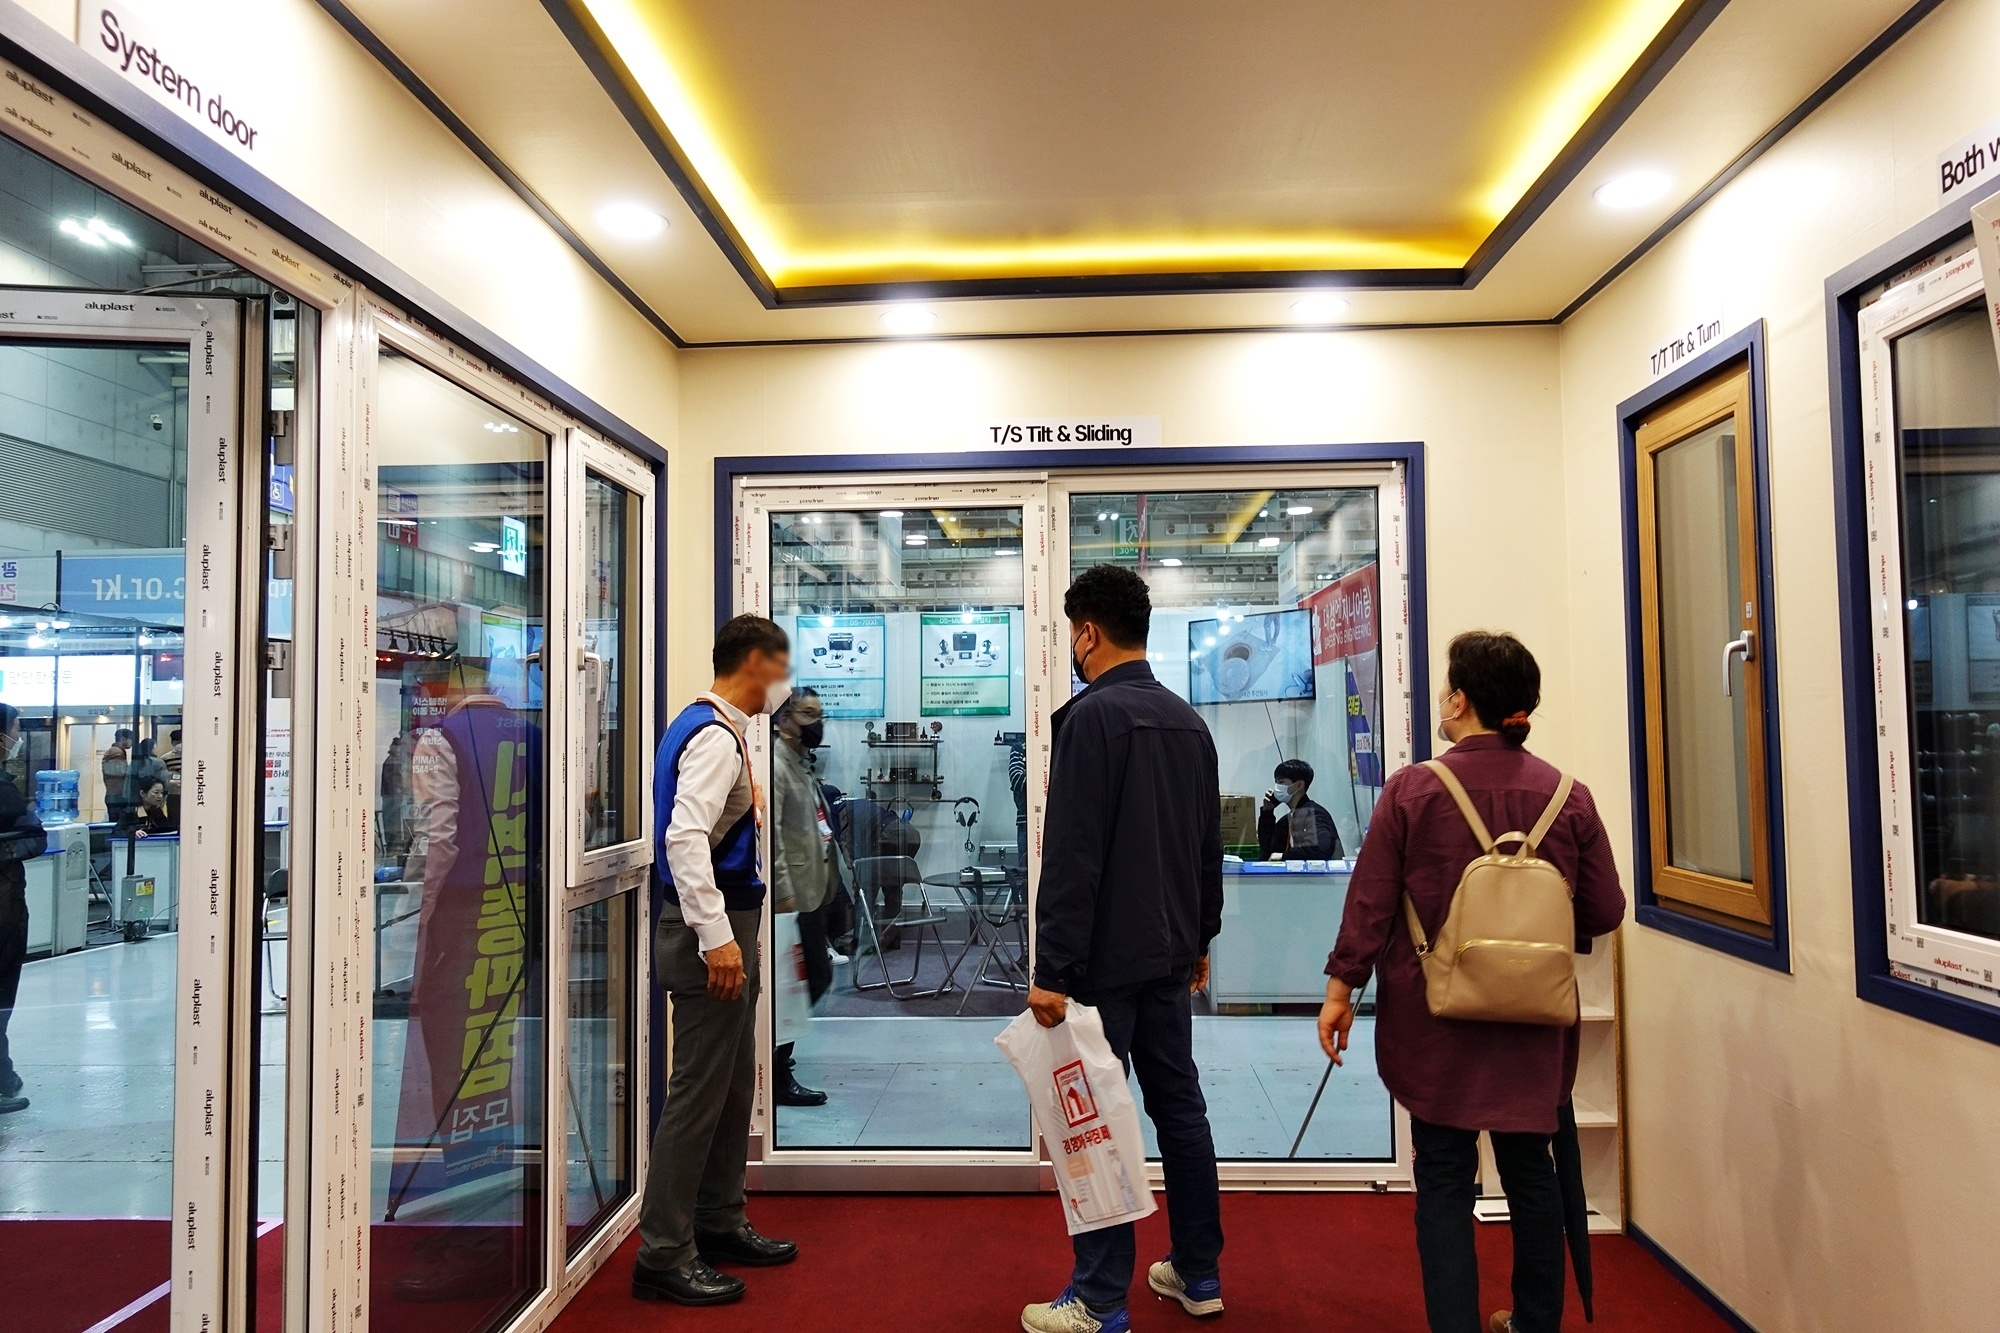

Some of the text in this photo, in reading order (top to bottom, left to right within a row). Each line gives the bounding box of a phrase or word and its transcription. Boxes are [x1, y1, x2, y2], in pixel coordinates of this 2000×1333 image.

[5, 70, 54, 106] aluplast
[101, 8, 258, 151] System door
[111, 152, 153, 182] aluplast
[1941, 144, 1985, 194] Both
[199, 189, 233, 215] aluplast
[271, 248, 300, 270] aluplast
[1945, 259, 1975, 279] aluplast
[84, 301, 136, 312] aluplast
[206, 330, 214, 377] aluplast
[1650, 318, 1721, 376] T/T Tilt & Turn
[989, 424, 1132, 446] T/S Tilt & Sliding
[219, 436, 227, 484] aluplast
[202, 544, 210, 591] aluplast
[213, 651, 222, 698] aluplast
[429, 706, 447, 716] 전시
[197, 759, 205, 807] aluplast
[412, 765, 439, 774] 1544-9
[210, 868, 218, 917] aluplast
[1886, 850, 1894, 895] aluplast
[1933, 957, 1964, 972] aluplast
[192, 978, 200, 1026] aluplast
[204, 1088, 212, 1137] aluplast
[1062, 1124, 1113, 1155] 경향하우징페
[187, 1201, 196, 1251] aluplast
